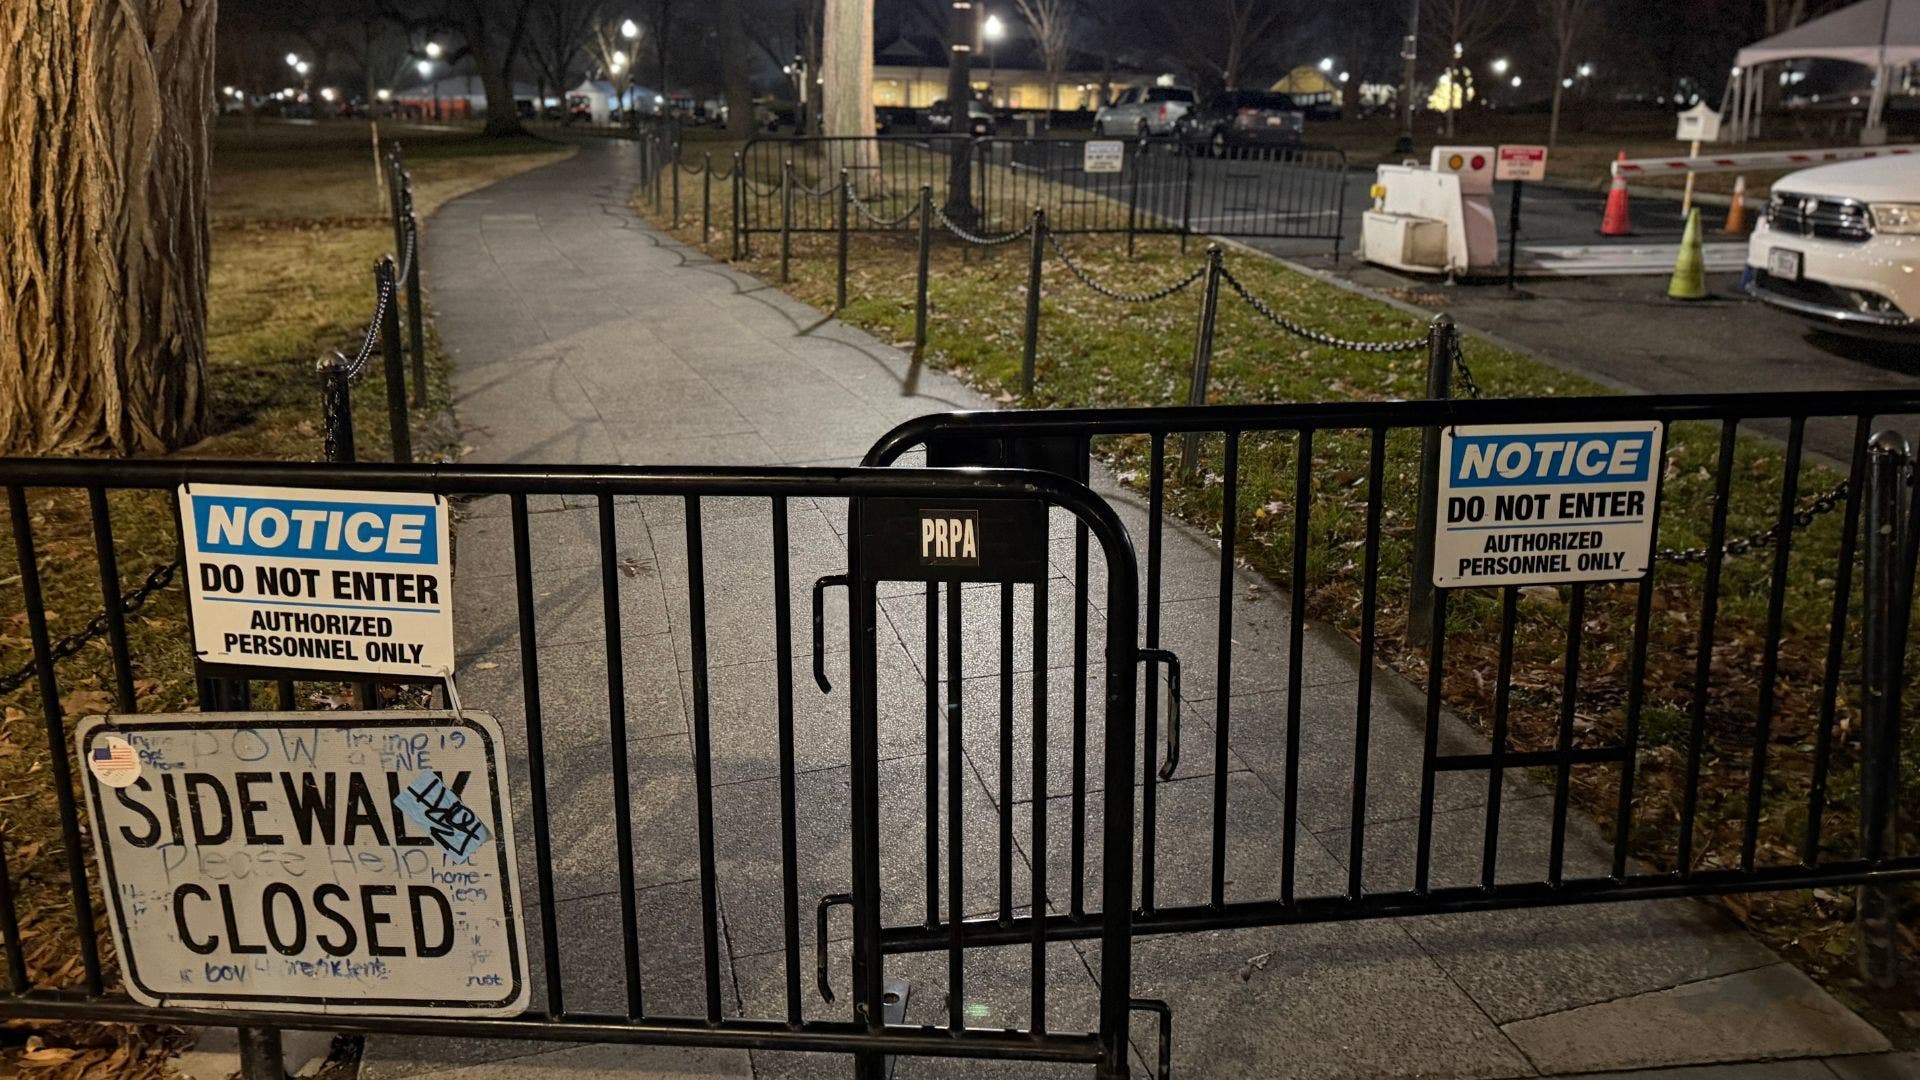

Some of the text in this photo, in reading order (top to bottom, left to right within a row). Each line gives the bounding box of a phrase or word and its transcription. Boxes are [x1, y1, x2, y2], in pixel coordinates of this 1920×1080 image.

[1458, 439, 1644, 480] NOTICE
[1447, 490, 1645, 523] DO NOT ENTER
[206, 504, 426, 554] NOTICE
[922, 518, 976, 557] PRPA
[1484, 531, 1603, 553] AUTHORIZED
[1459, 552, 1625, 576] PERSONNEL ONLY
[200, 563, 439, 604] DO NOT ENTER
[250, 610, 392, 637] AUTHORIZED
[224, 633, 424, 664] PERSONNEL ONLY
[173, 881, 455, 958] CLOSED
